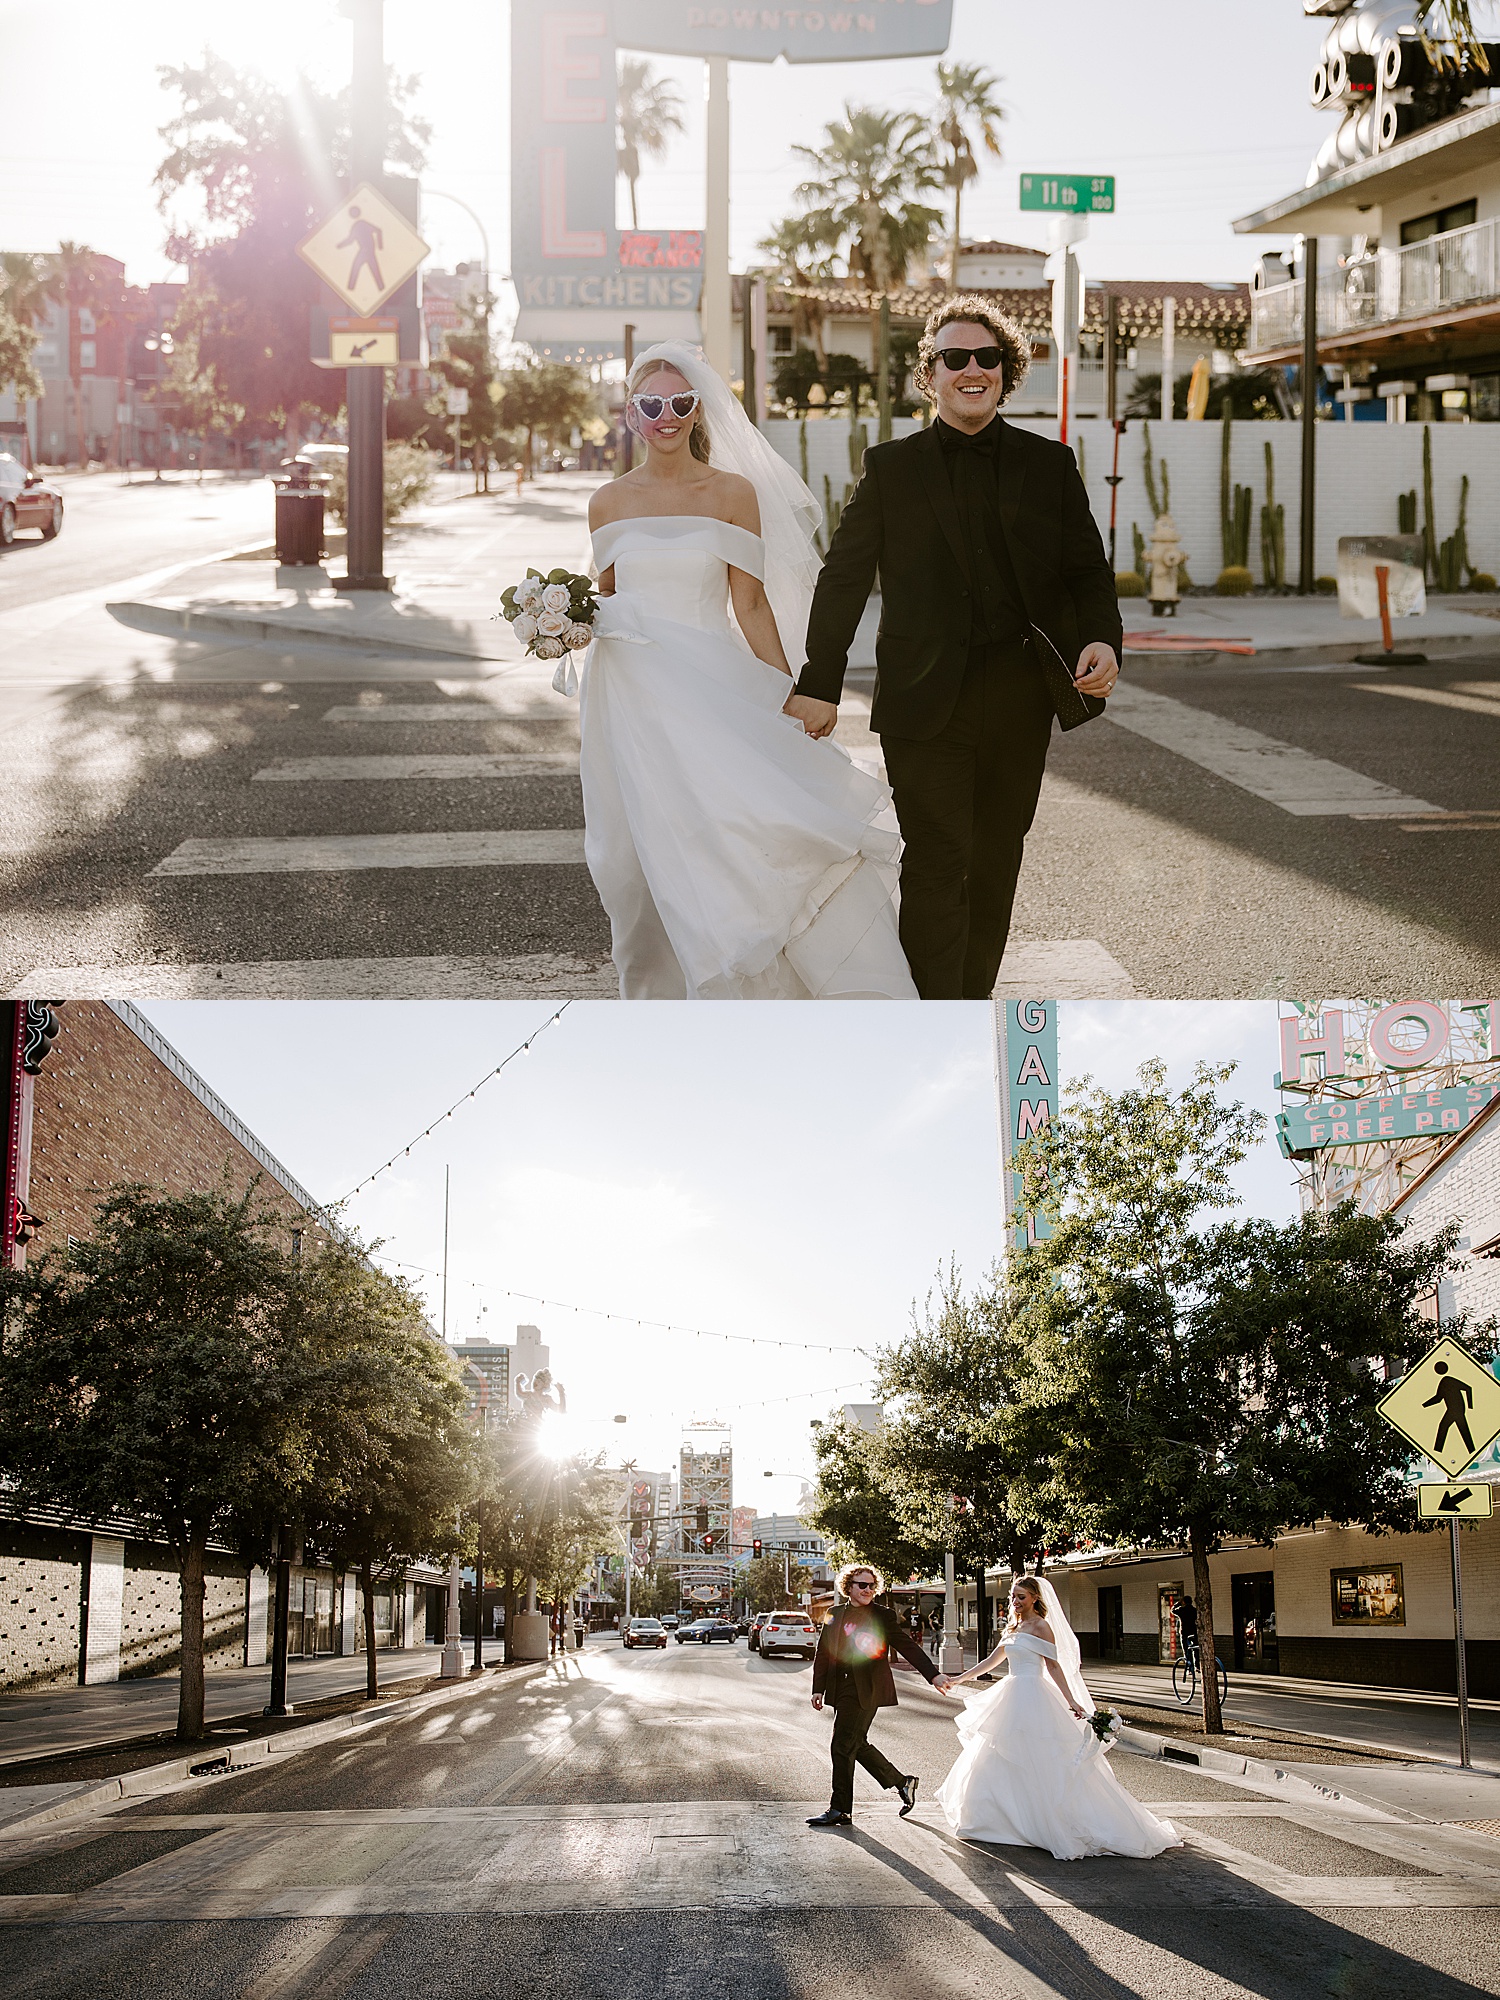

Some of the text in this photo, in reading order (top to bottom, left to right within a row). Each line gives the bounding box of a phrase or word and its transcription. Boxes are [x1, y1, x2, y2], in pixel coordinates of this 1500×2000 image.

[687, 6, 876, 33] DOWNTOWN
[1023, 177, 1032, 191] N
[1091, 178, 1106, 193] ST
[1092, 195, 1112, 210] 100
[669, 230, 701, 249] NO
[619, 248, 703, 268] VACANCY
[523, 276, 694, 306] KITCHENS
[1304, 1090, 1443, 1122] COFFEE
[1310, 1115, 1396, 1144] FREE
[491, 1356, 502, 1399] VEGAS
